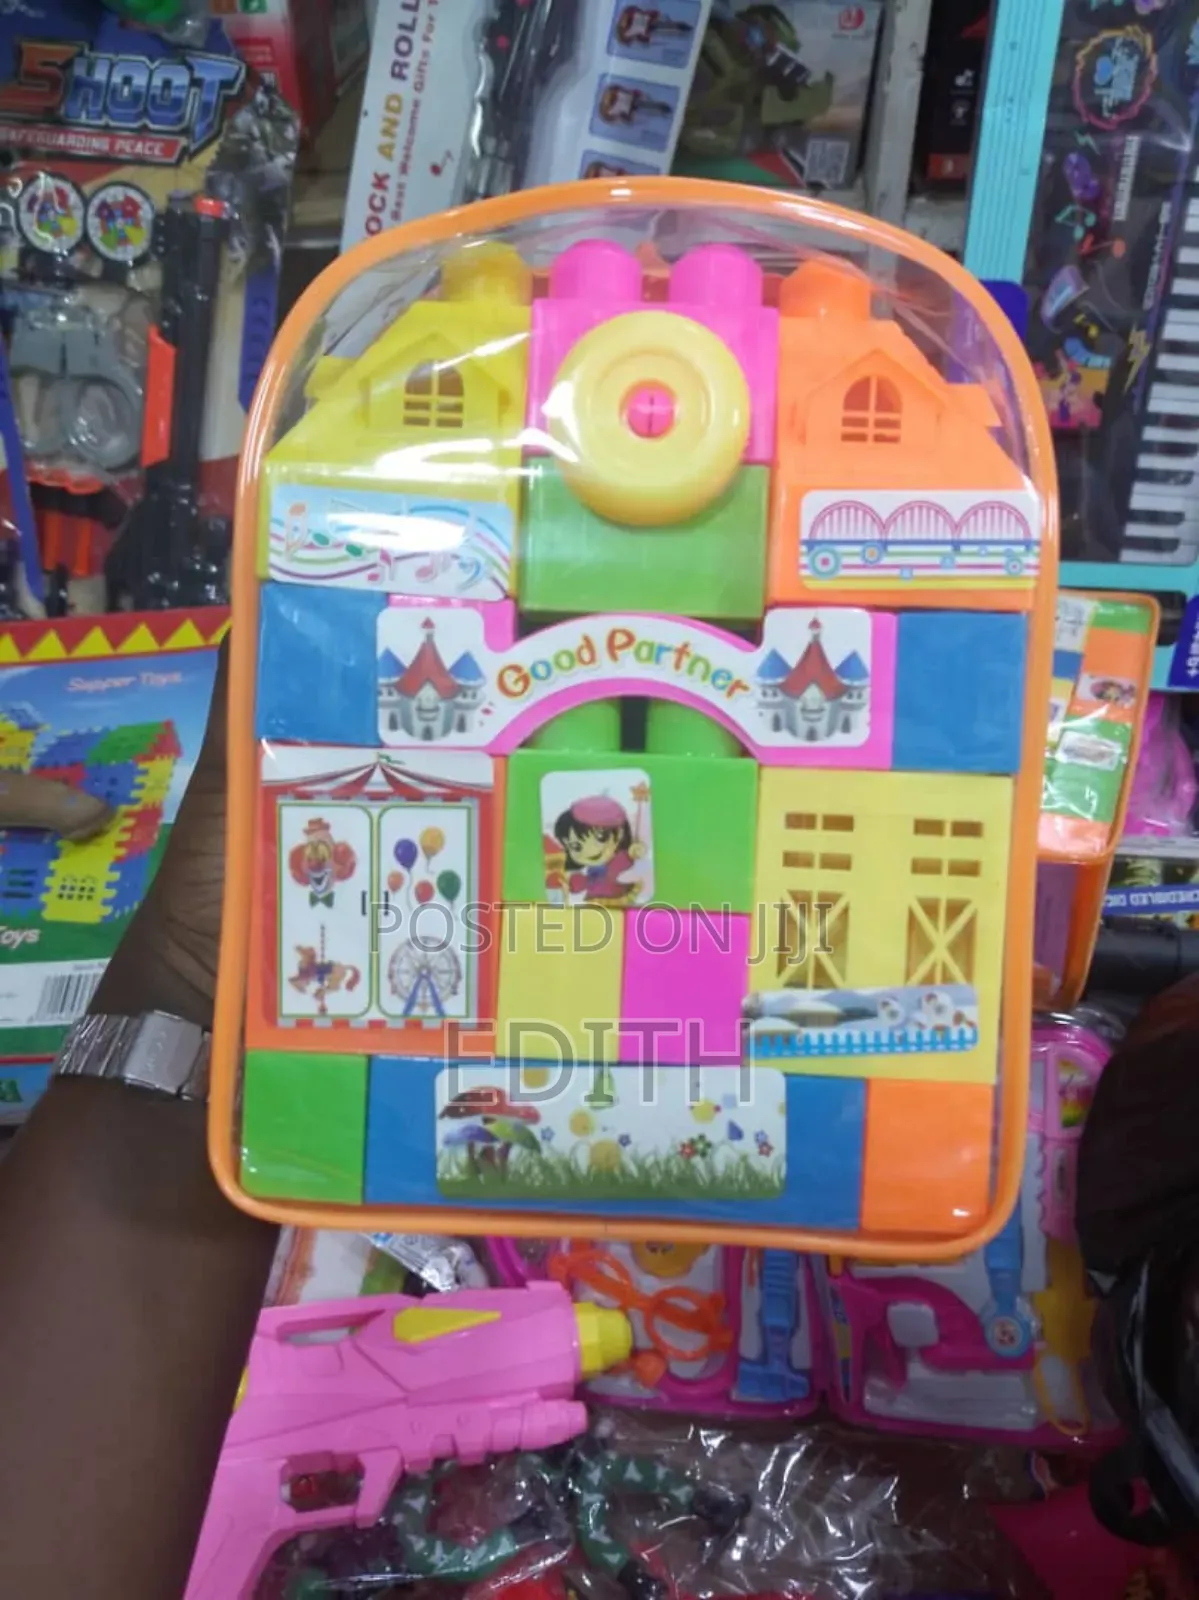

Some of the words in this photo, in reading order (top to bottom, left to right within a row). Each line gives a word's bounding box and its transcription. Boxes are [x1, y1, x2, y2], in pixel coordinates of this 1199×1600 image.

[391, 0, 420, 80] ROLL
[0, 41, 246, 151] SHOOT
[377, 94, 402, 161] AND
[400, 99, 421, 176] Welcome
[413, 49, 430, 93] Gifts
[422, 13, 435, 43] For
[114, 138, 165, 156] PEACE
[365, 172, 390, 236] OCK
[497, 634, 597, 698] Good
[606, 628, 750, 698] Partner
